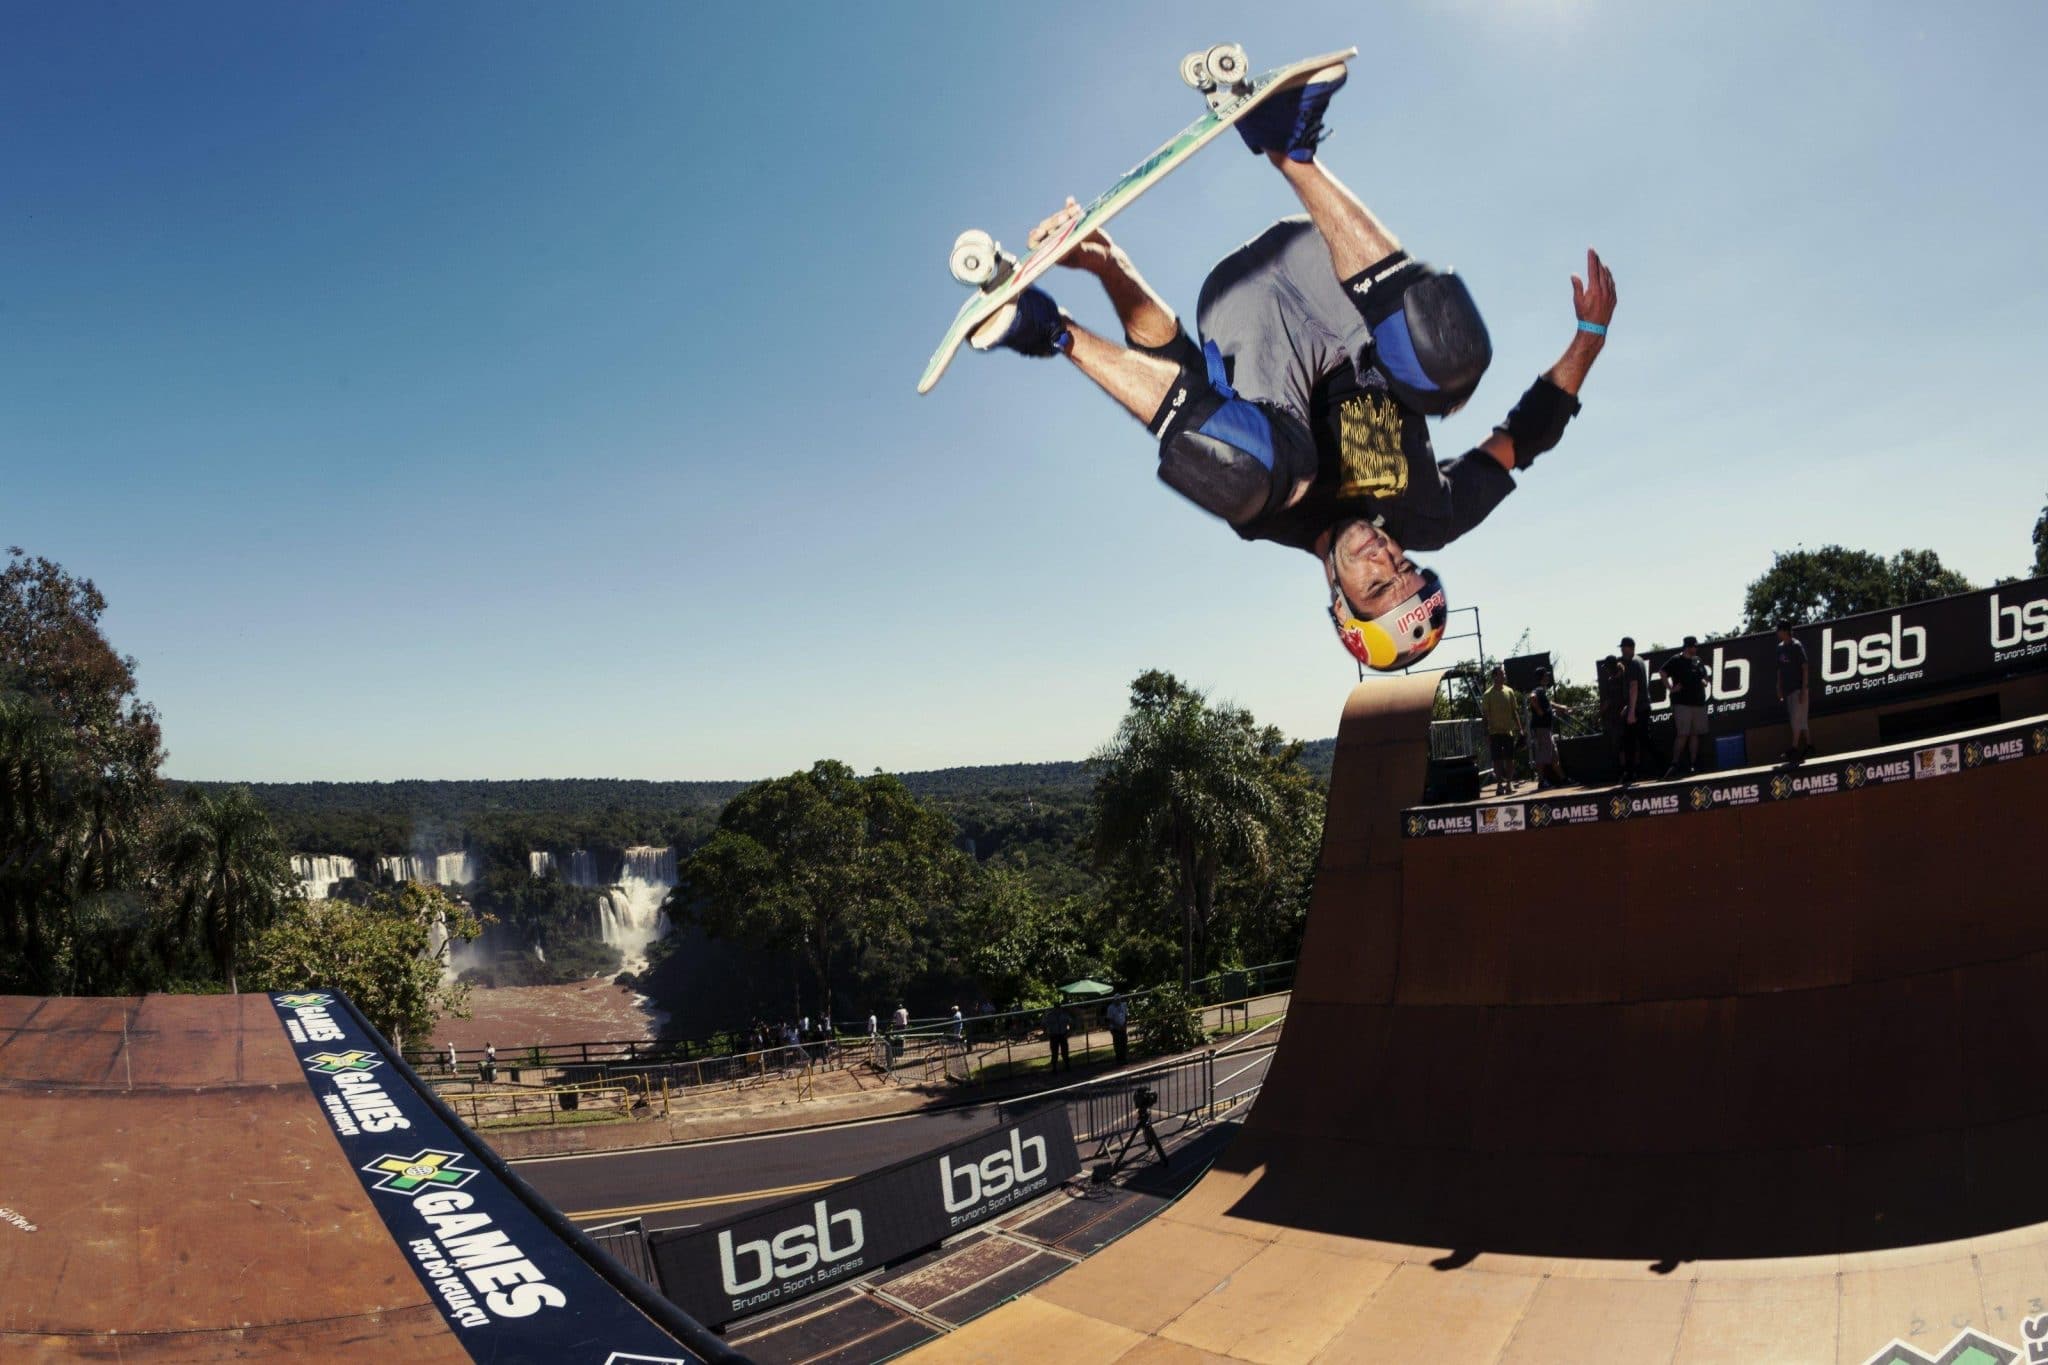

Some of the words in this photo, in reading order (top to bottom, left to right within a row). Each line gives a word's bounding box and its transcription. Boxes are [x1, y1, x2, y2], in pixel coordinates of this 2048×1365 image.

[1397, 606, 1426, 634] Bull
[1821, 614, 1927, 682] bsb
[1862, 677, 1886, 690] Sport
[1888, 669, 1923, 684] Business
[1983, 738, 2023, 758] GAMES
[1792, 772, 1838, 792] GAMES
[1866, 760, 1911, 780] GAMES
[1631, 795, 1679, 812] GAMES
[1712, 784, 1759, 802] GAMES
[1428, 816, 1472, 831] GAMES
[1551, 803, 1599, 820] GAMES
[294, 1006, 346, 1042] GAMES
[332, 1071, 411, 1133] GAMES
[939, 1127, 1047, 1213] bsb
[988, 1193, 1012, 1211] Sport
[1013, 1177, 1048, 1200] Business
[408, 1237, 443, 1261] FOZ
[412, 1190, 567, 1318] GAMES
[718, 1200, 864, 1295] bsb
[422, 1259, 454, 1278] DO
[783, 1274, 815, 1294] Sport
[817, 1256, 864, 1281] Business
[434, 1276, 491, 1328] IGUAÇU
